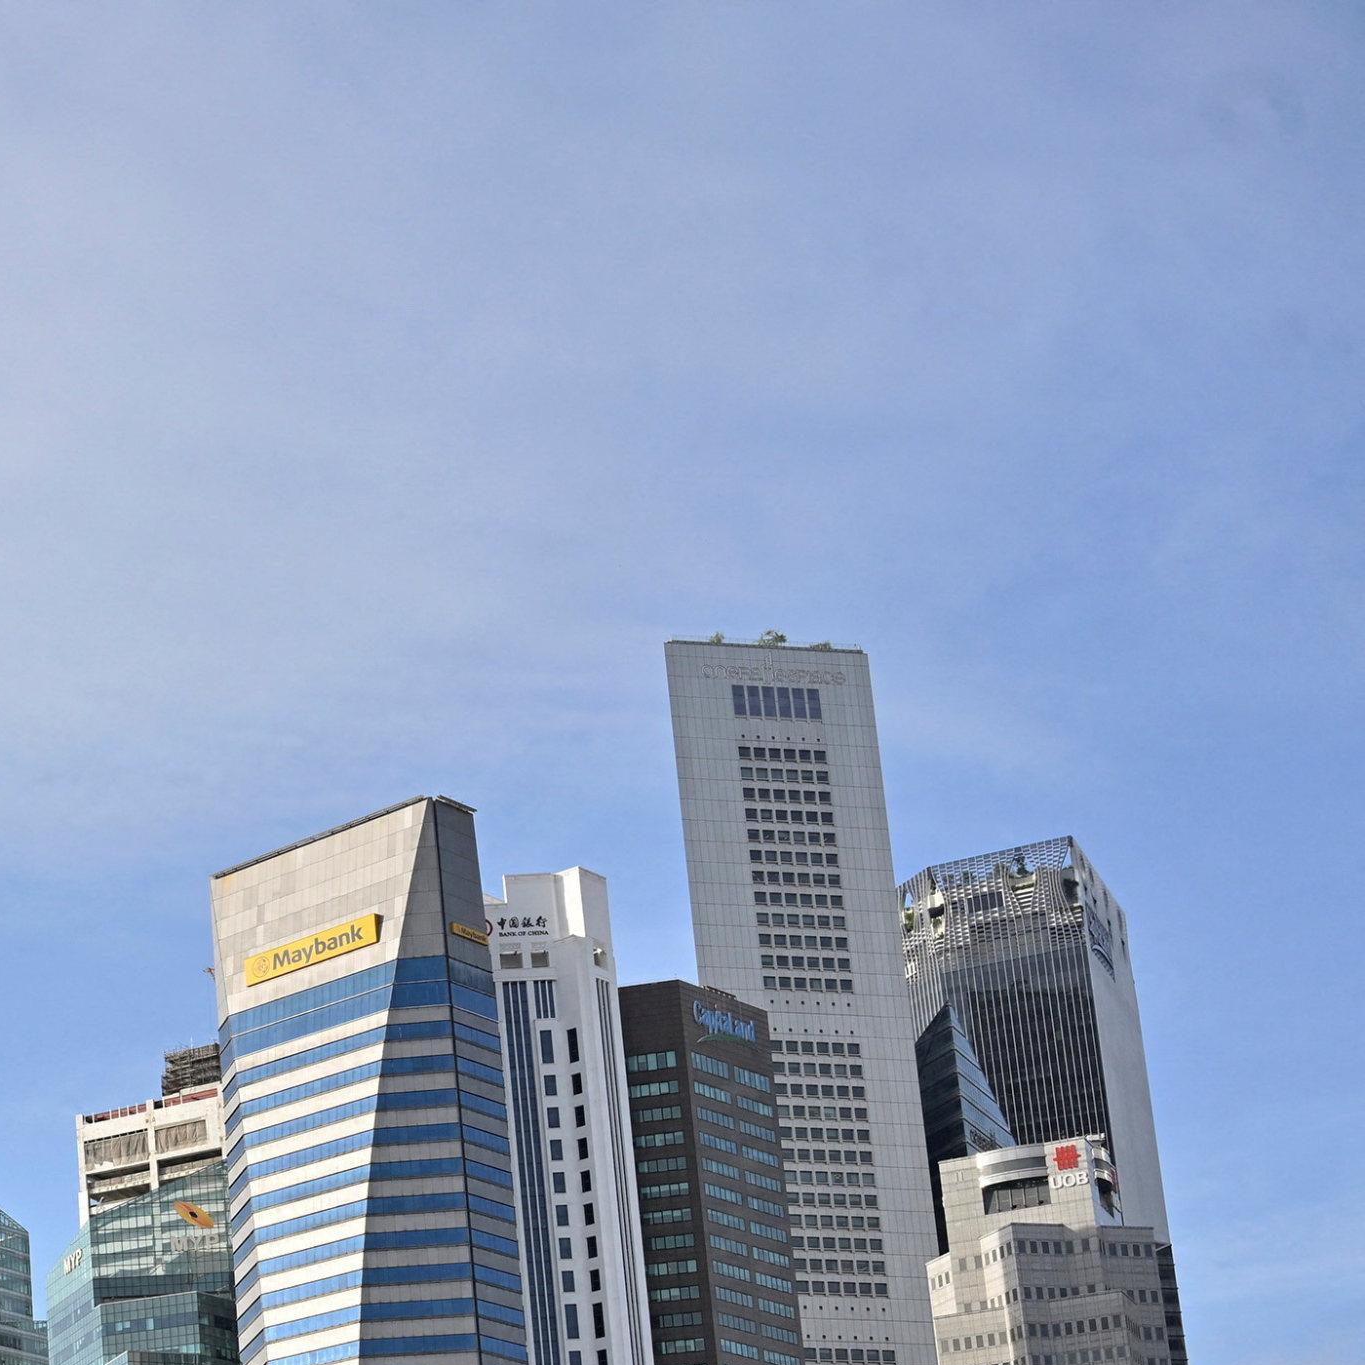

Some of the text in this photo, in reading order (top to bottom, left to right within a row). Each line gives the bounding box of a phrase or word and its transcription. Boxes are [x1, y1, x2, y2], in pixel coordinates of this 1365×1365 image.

[272, 924, 364, 970] Maybank
[693, 1000, 757, 1042] CapitaLand
[1050, 1172, 1089, 1190] UOB
[171, 1233, 220, 1252] MYP
[63, 1249, 83, 1274] MYP
